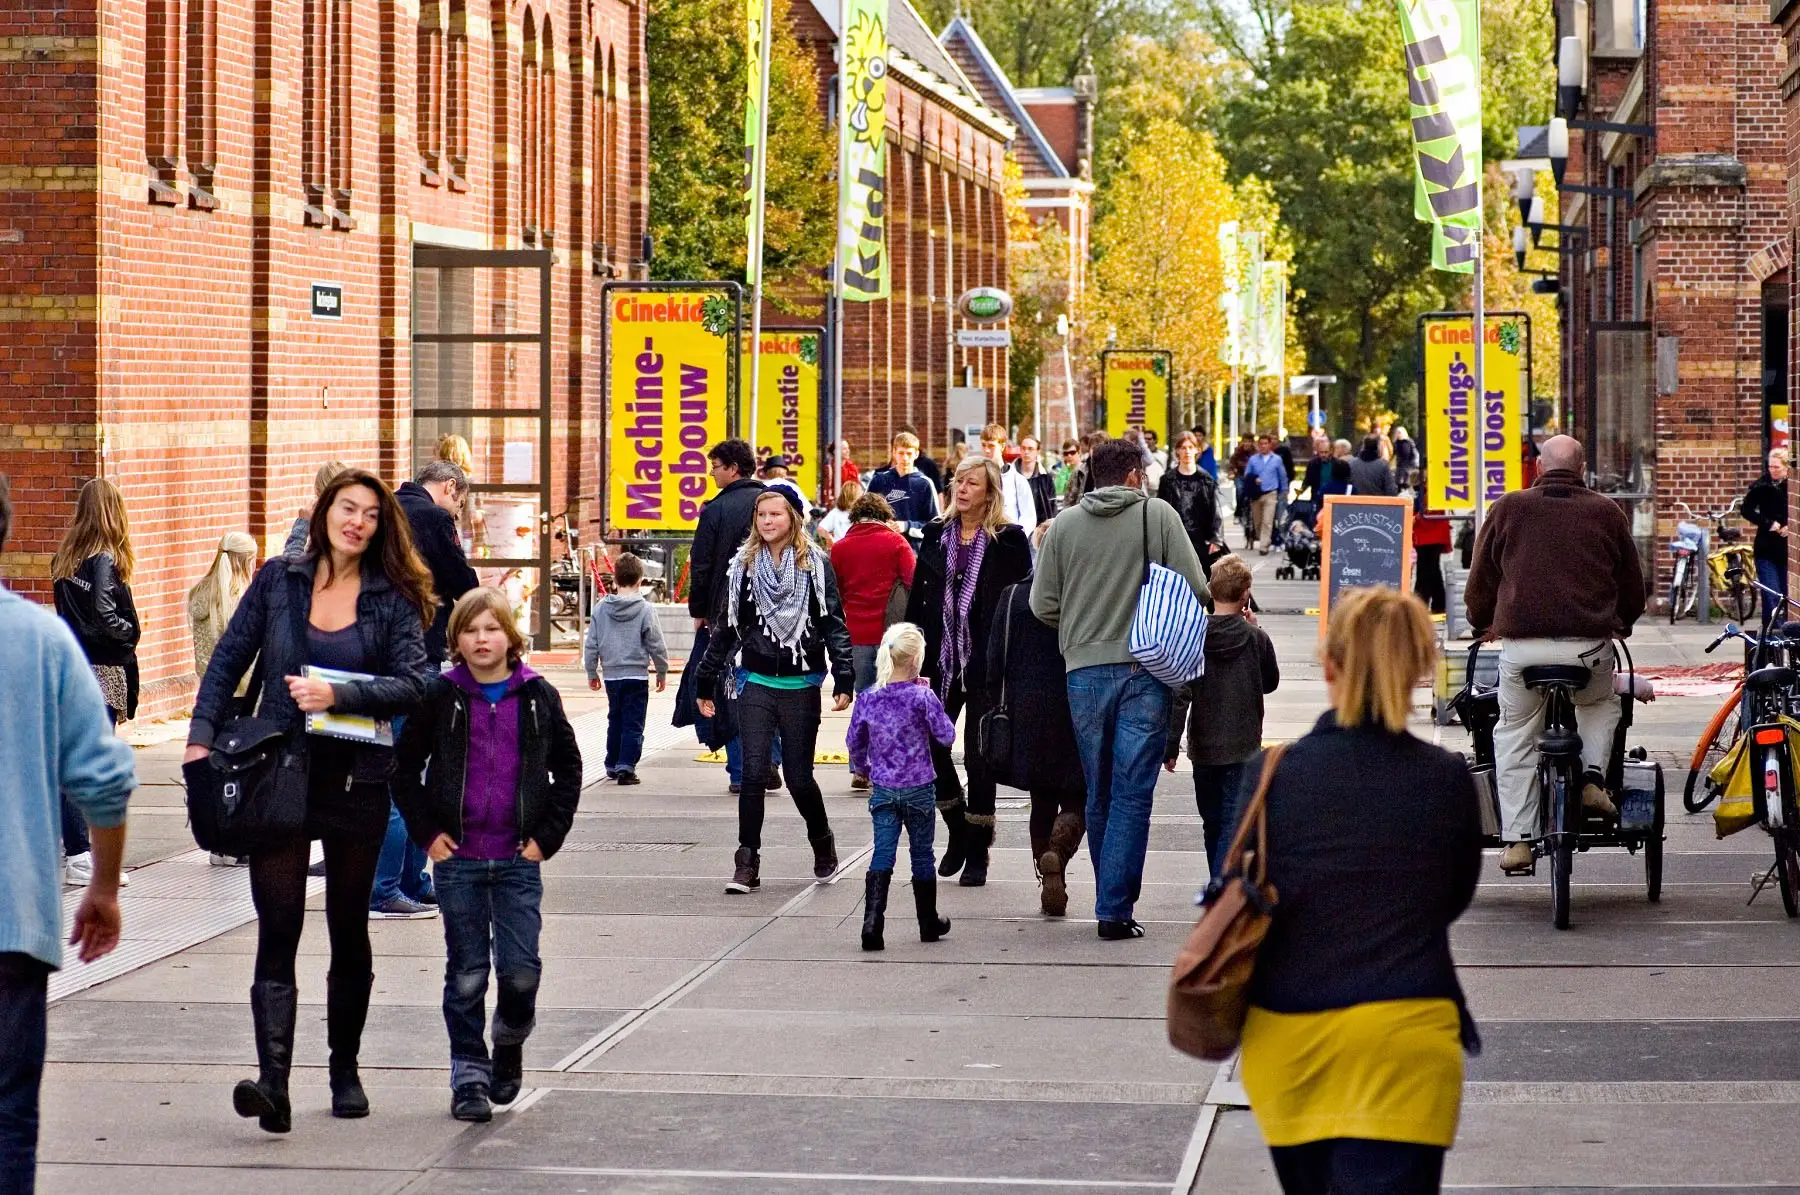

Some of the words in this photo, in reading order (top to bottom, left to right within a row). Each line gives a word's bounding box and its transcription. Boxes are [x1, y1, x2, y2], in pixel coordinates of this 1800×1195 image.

[616, 297, 704, 322] Cinekid
[624, 336, 664, 521] Machine-
[668, 363, 708, 522] gebouw
[776, 364, 804, 478] ganisatie
[1443, 352, 1474, 501] Zuiverings-
[1485, 390, 1505, 451] Oost
